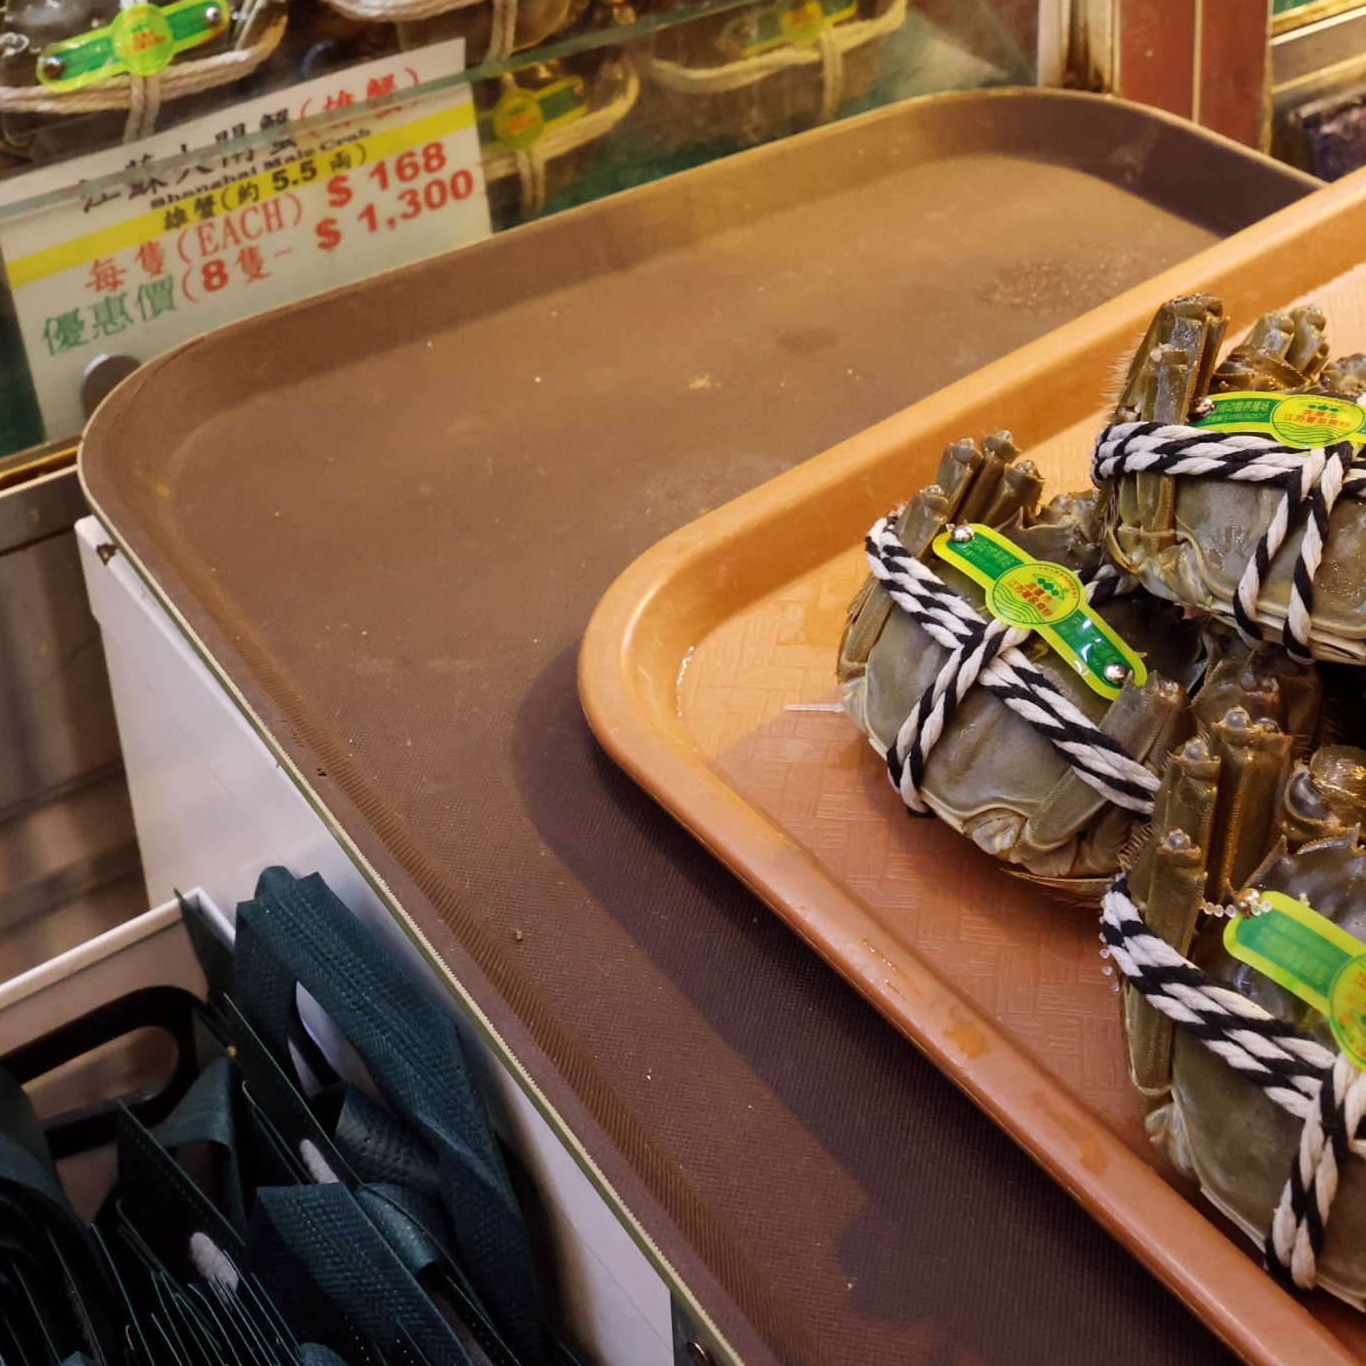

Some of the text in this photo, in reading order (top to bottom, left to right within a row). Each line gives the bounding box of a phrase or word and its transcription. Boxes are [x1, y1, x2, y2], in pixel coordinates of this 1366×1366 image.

[149, 127, 371, 210] Shanghai Male Crab
[369, 141, 448, 192] 168
